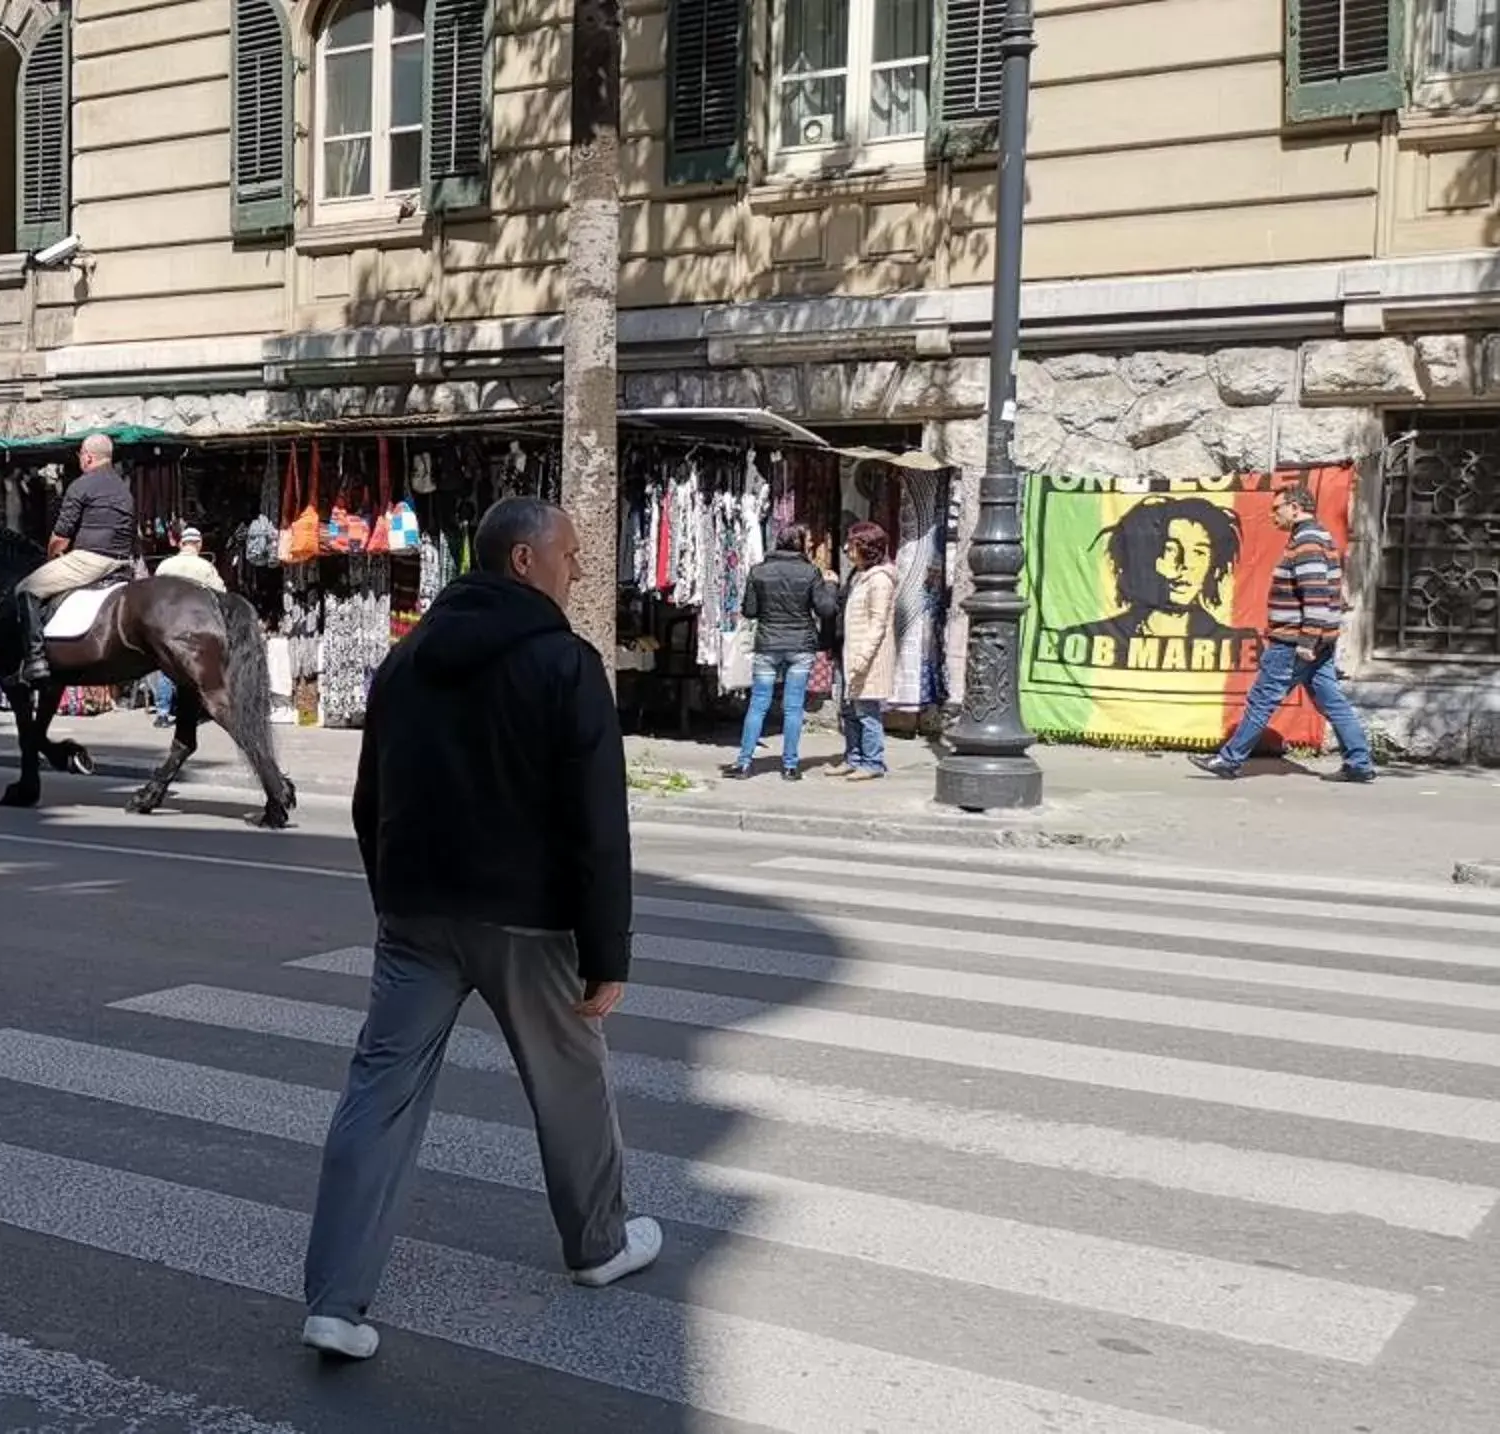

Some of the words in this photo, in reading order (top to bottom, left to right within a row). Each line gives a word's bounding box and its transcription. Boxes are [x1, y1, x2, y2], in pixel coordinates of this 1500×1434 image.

[1051, 474, 1149, 491] ON
[1038, 630, 1116, 667] BOB
[1127, 637, 1257, 671] MARLE
